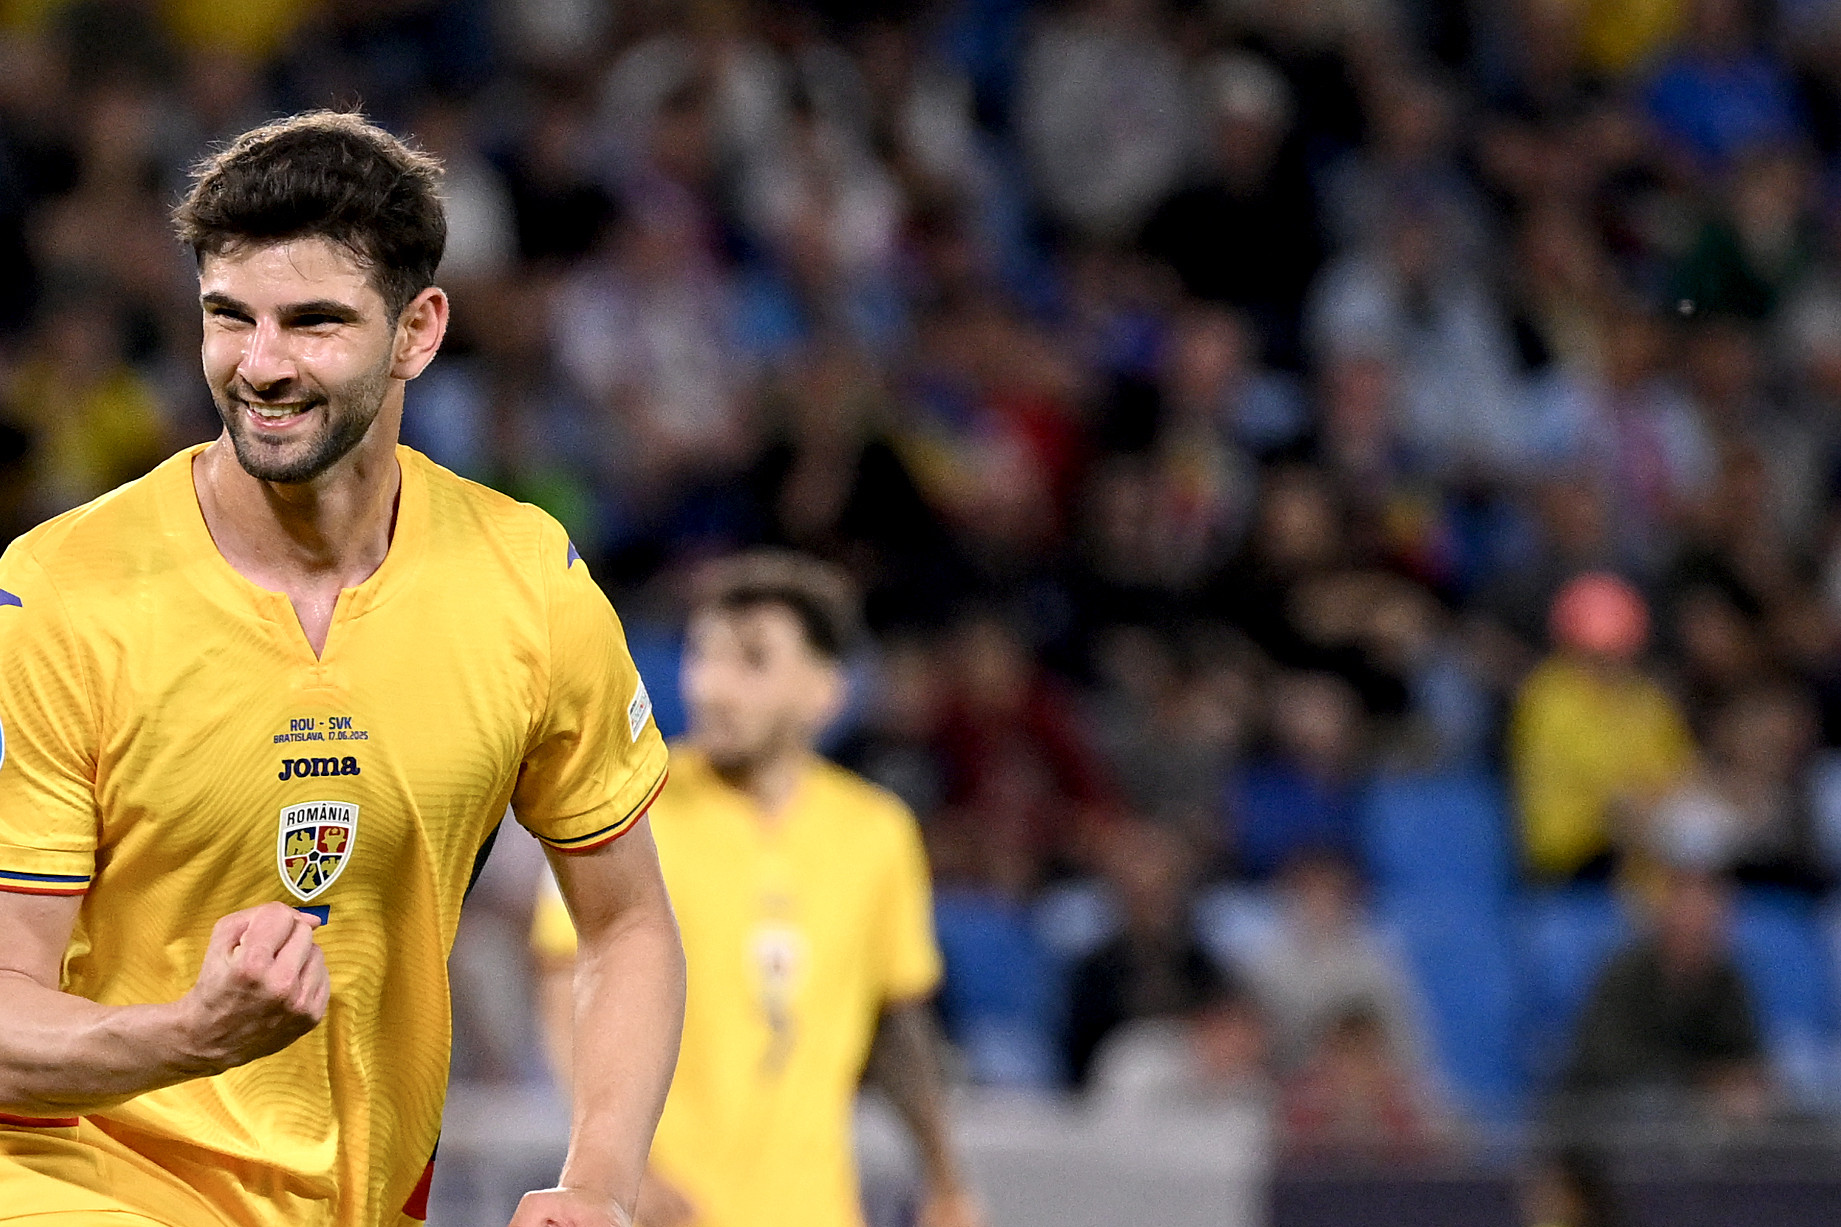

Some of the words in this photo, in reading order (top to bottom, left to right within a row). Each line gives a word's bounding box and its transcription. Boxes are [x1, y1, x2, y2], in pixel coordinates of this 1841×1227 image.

[290, 718, 314, 731] ROU
[328, 717, 352, 729] SVK
[273, 732, 325, 743] BRATISLAVA,
[328, 731, 368, 740] 17.06.2025
[287, 803, 350, 827] ROMÂNIA
